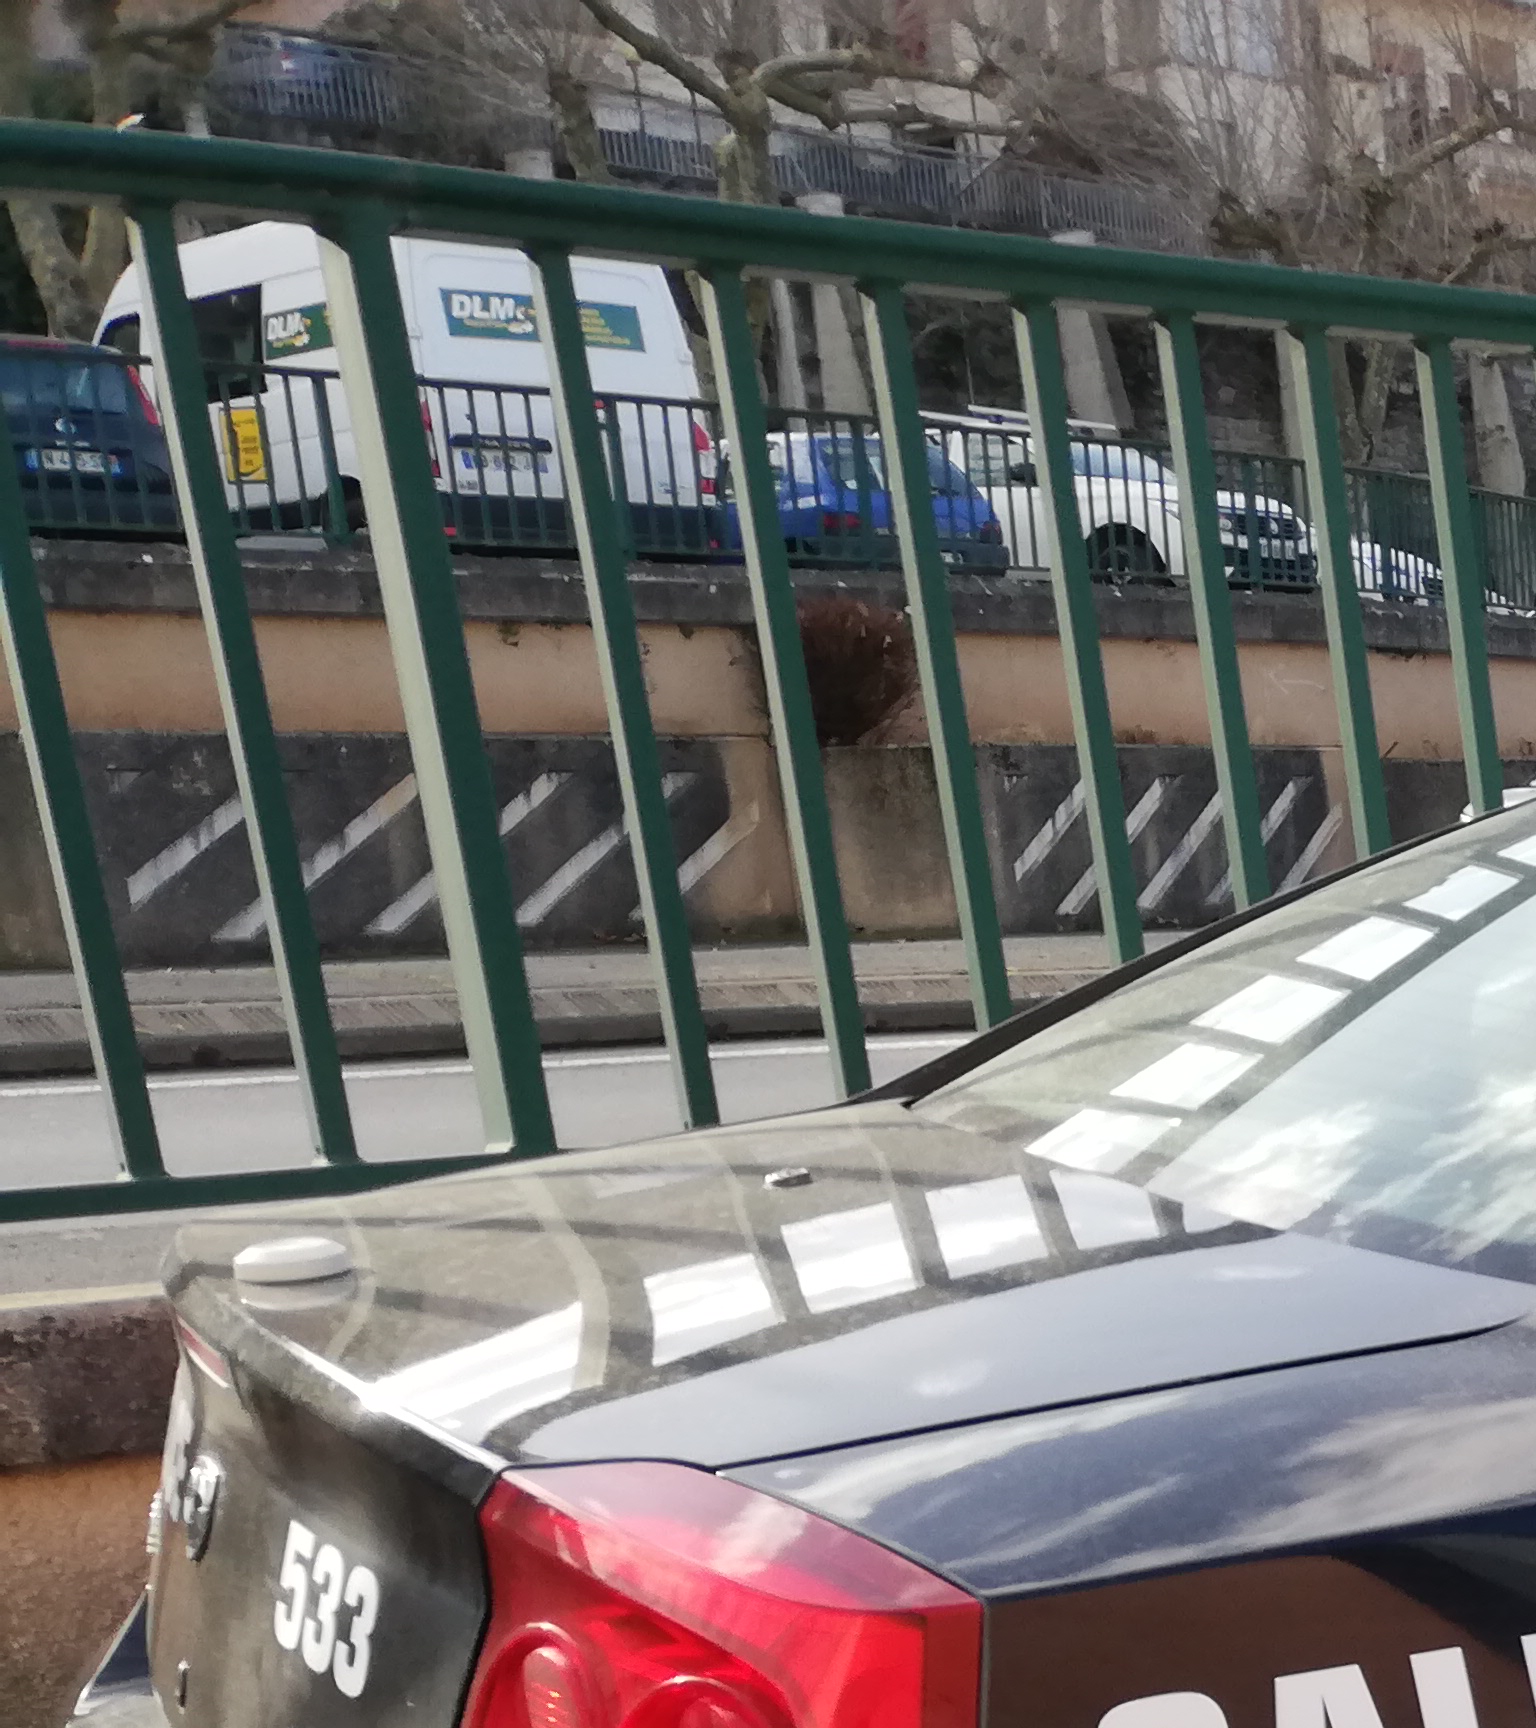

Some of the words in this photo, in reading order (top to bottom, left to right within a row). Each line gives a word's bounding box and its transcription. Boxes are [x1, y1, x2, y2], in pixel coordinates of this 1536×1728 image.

[451, 293, 516, 321] DLM
[266, 311, 306, 342] DLM
[273, 1519, 380, 1698] 533
